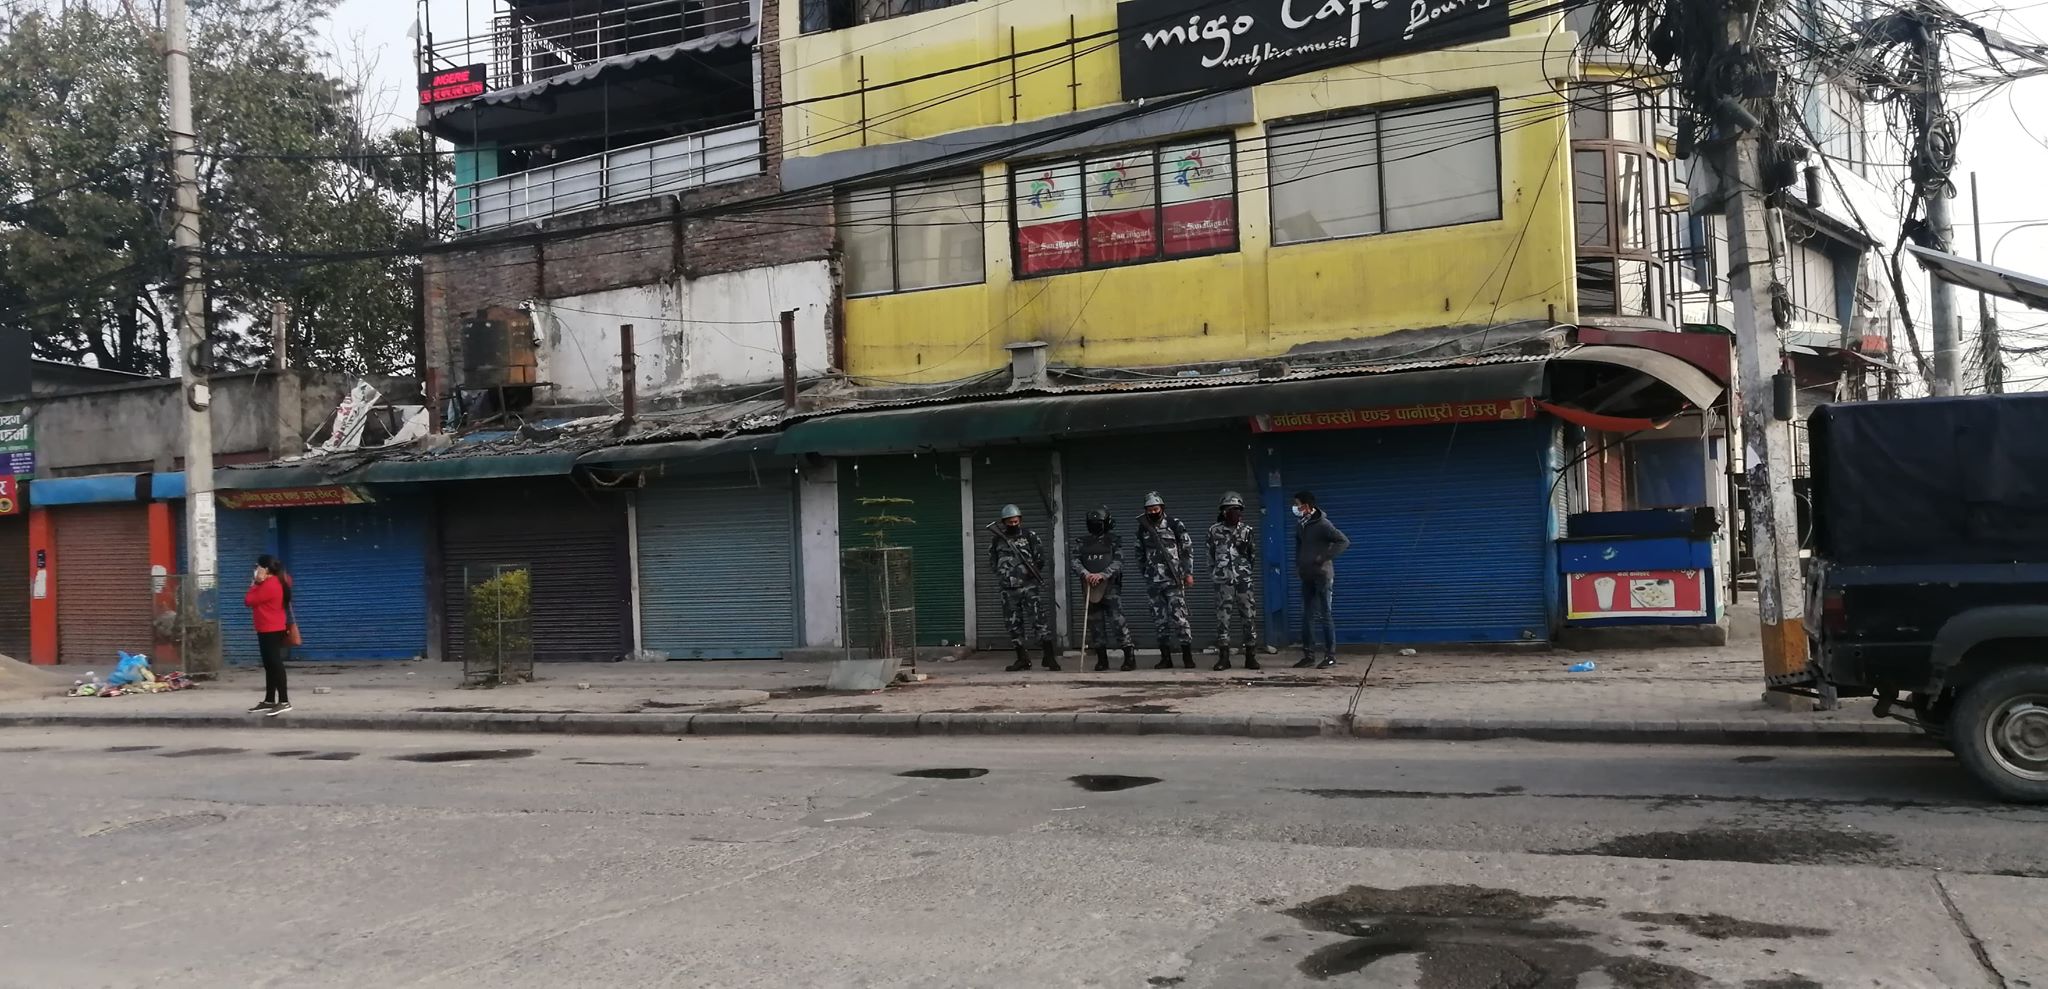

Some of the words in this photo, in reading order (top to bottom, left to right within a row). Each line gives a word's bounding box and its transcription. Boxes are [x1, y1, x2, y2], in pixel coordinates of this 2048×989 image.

[1141, 15, 1254, 68] migo
[1222, 42, 1260, 75] with
[1264, 42, 1293, 61] live
[1297, 35, 1348, 54] music
